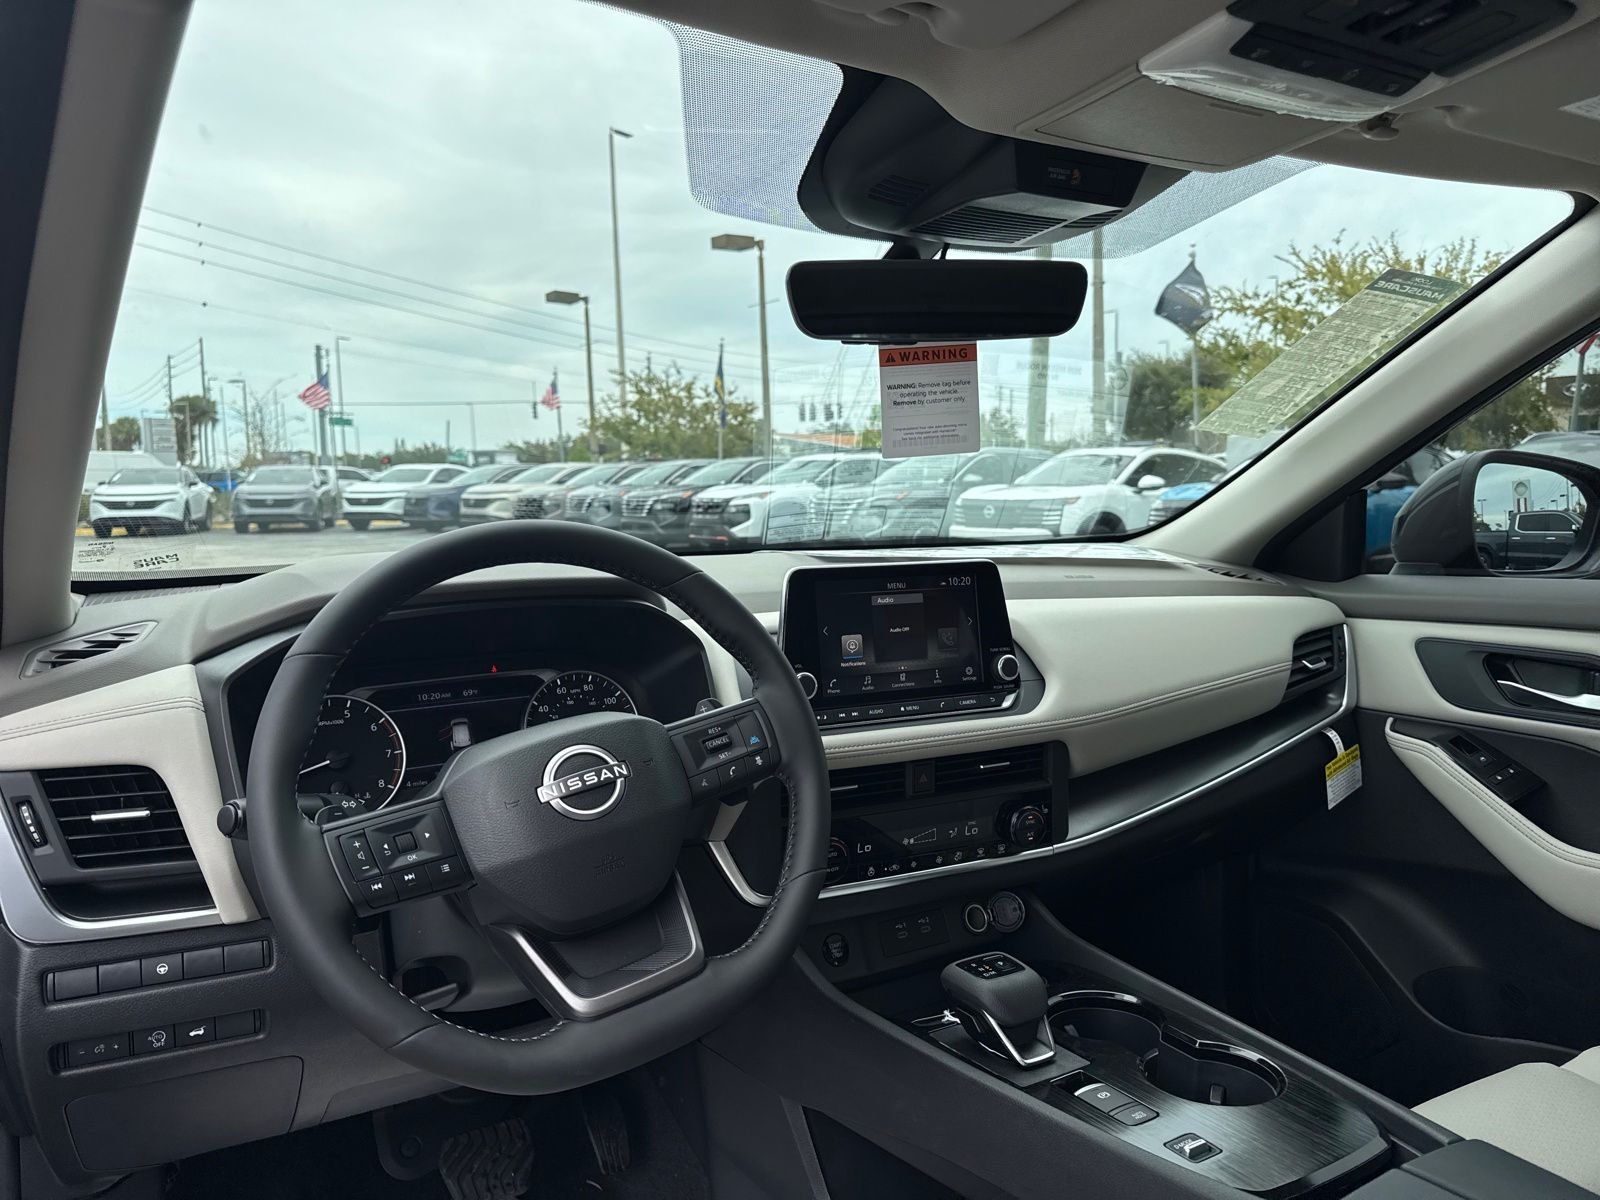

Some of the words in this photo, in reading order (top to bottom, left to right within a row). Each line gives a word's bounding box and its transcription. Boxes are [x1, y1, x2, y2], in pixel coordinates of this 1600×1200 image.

[899, 348, 968, 362] WARNING
[942, 380, 952, 388] tag
[899, 390, 927, 398] operating
[917, 398, 925, 406] by
[948, 576, 971, 586] 10:20
[887, 582, 906, 590] MENU
[556, 686, 567, 695] 60
[583, 683, 594, 692] 80
[604, 696, 617, 705] 100
[538, 704, 549, 713] 40
[344, 709, 351, 718] 5
[370, 722, 377, 731] 6
[707, 726, 721, 735] RES+
[707, 736, 729, 749] CANCEL
[385, 749, 391, 758] 7
[378, 779, 385, 788] 8
[541, 763, 628, 800] NISSAN
[964, 825, 979, 836] Lo
[857, 842, 872, 854] Lo
[407, 853, 417, 862] OK
